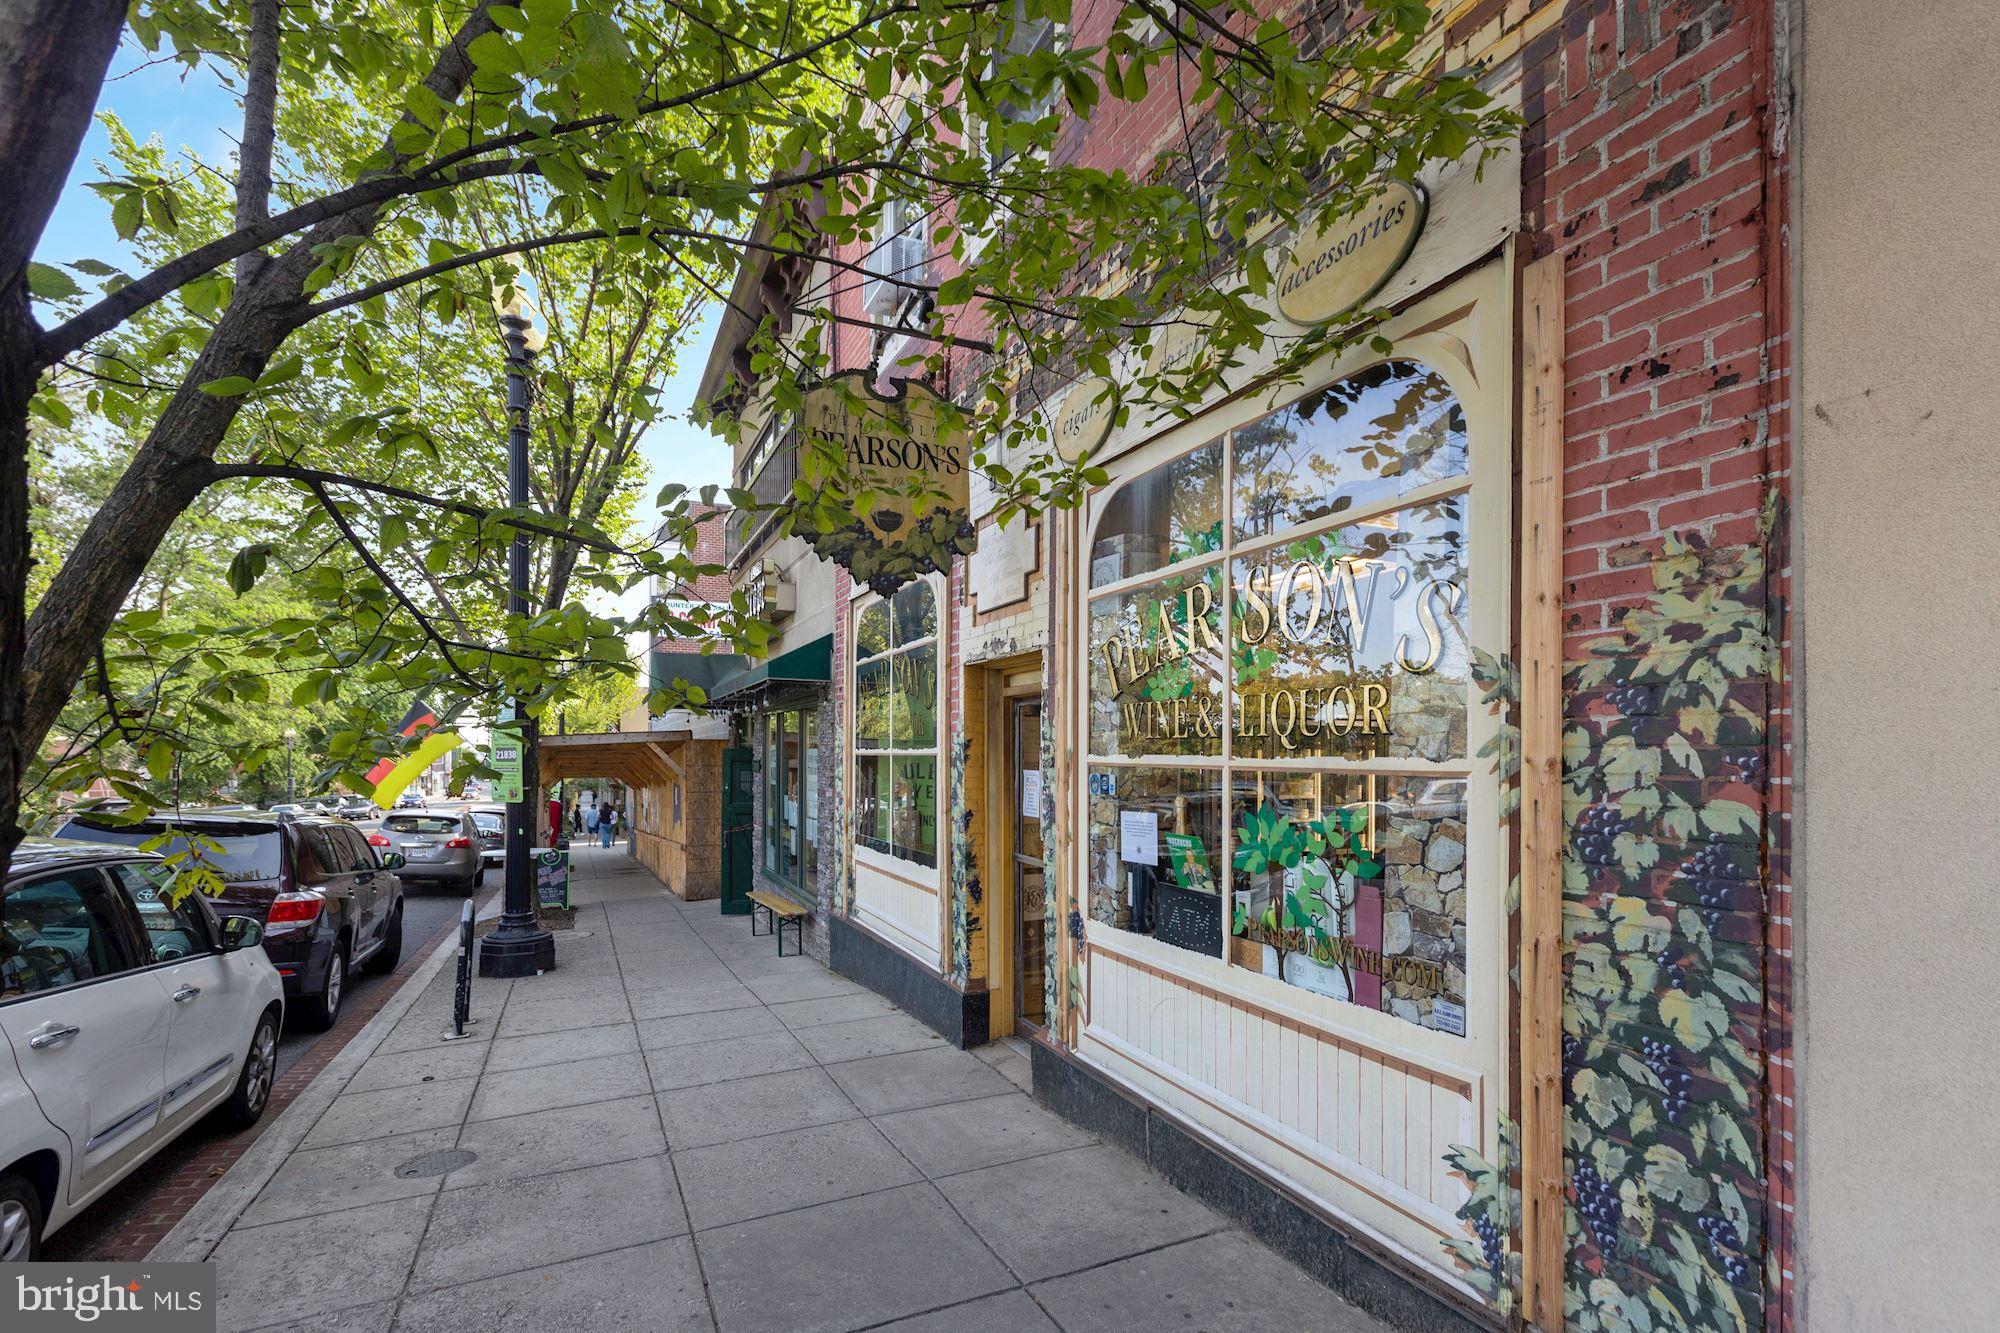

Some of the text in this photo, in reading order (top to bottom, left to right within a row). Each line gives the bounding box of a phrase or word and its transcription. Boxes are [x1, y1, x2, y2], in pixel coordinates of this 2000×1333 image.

[1281, 200, 1406, 297] accessories
[1063, 402, 1101, 436] cigars
[1100, 558, 1465, 701] PEARSON'S
[1123, 683, 1395, 752] WINE & LIQUOR
[496, 750, 517, 760] 21838
[1167, 906, 1210, 939] ATM
